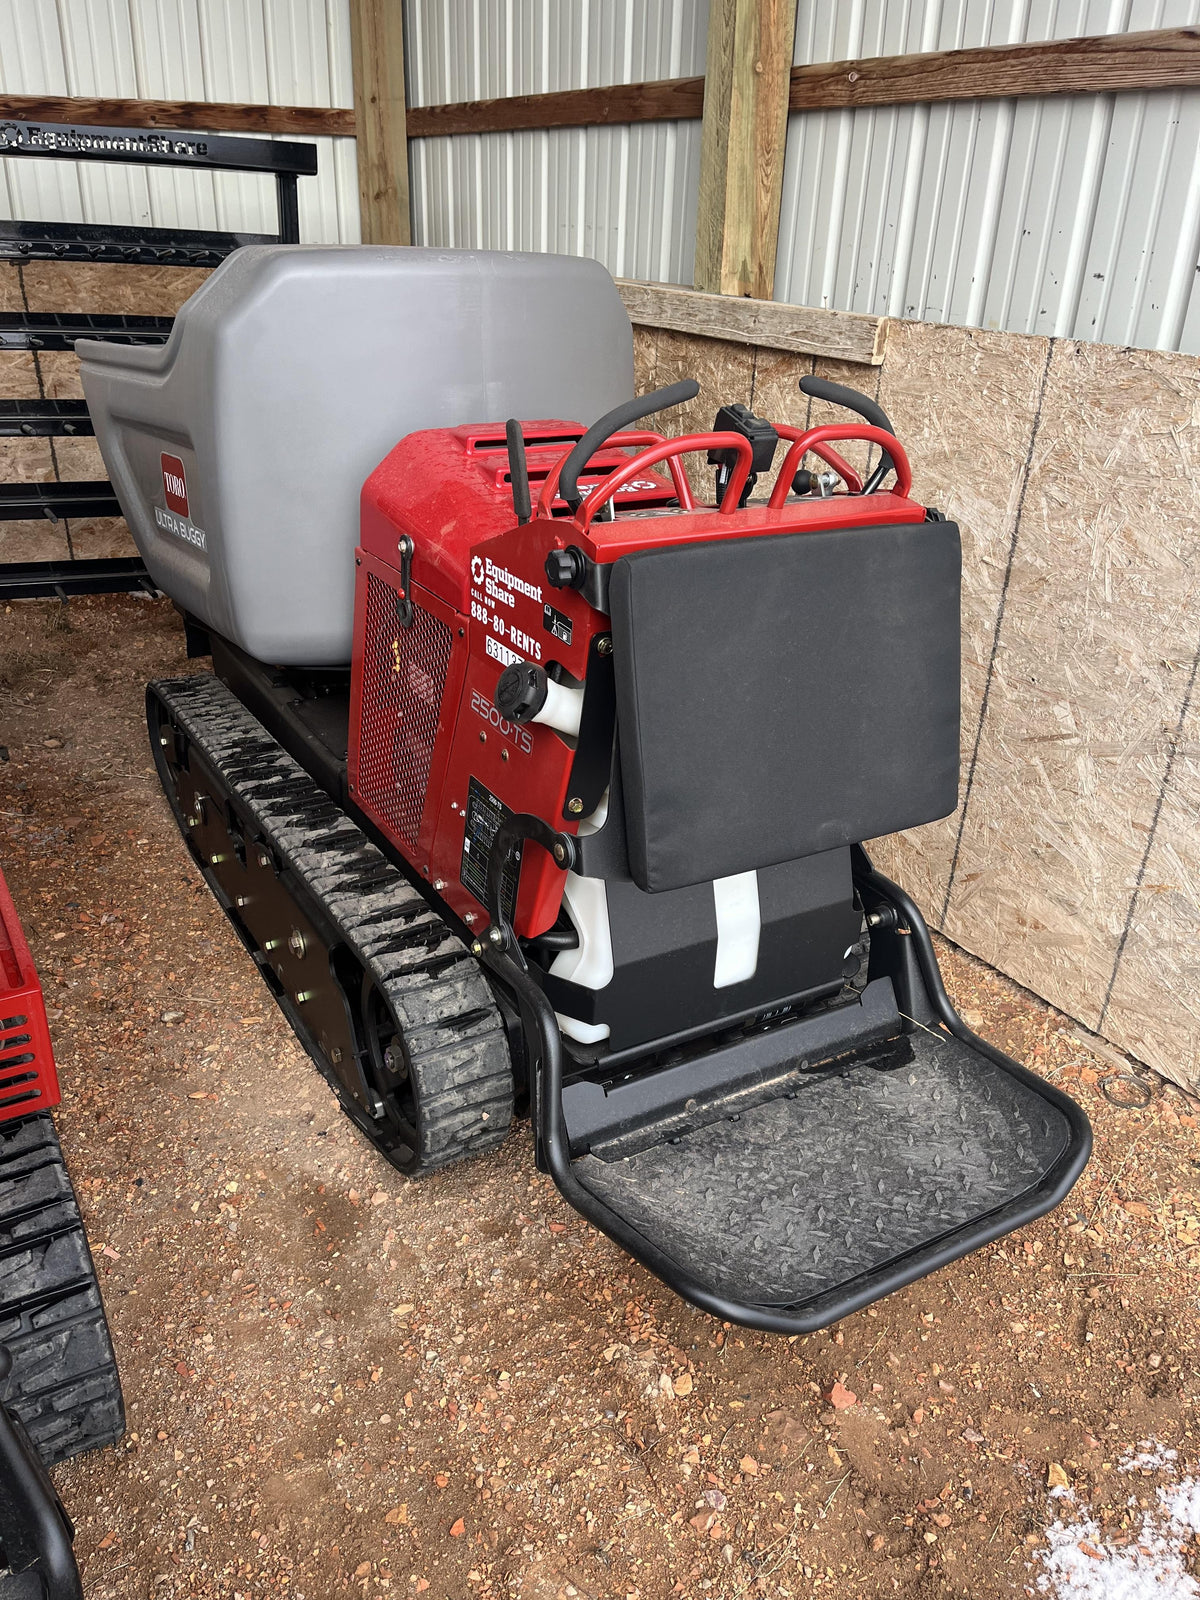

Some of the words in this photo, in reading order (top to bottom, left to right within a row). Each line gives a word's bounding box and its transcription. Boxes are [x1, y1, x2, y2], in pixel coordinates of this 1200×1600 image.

[27, 126, 208, 156] EquipmentShare
[163, 471, 185, 499] TORO
[155, 509, 180, 535] ULTRA
[179, 521, 206, 549] BUGGY
[485, 557, 543, 603] Equipment
[485, 577, 515, 608] Share
[471, 588, 483, 602] CALL
[484, 595, 496, 609] NOW
[471, 601, 542, 660] 888-80-RENTS
